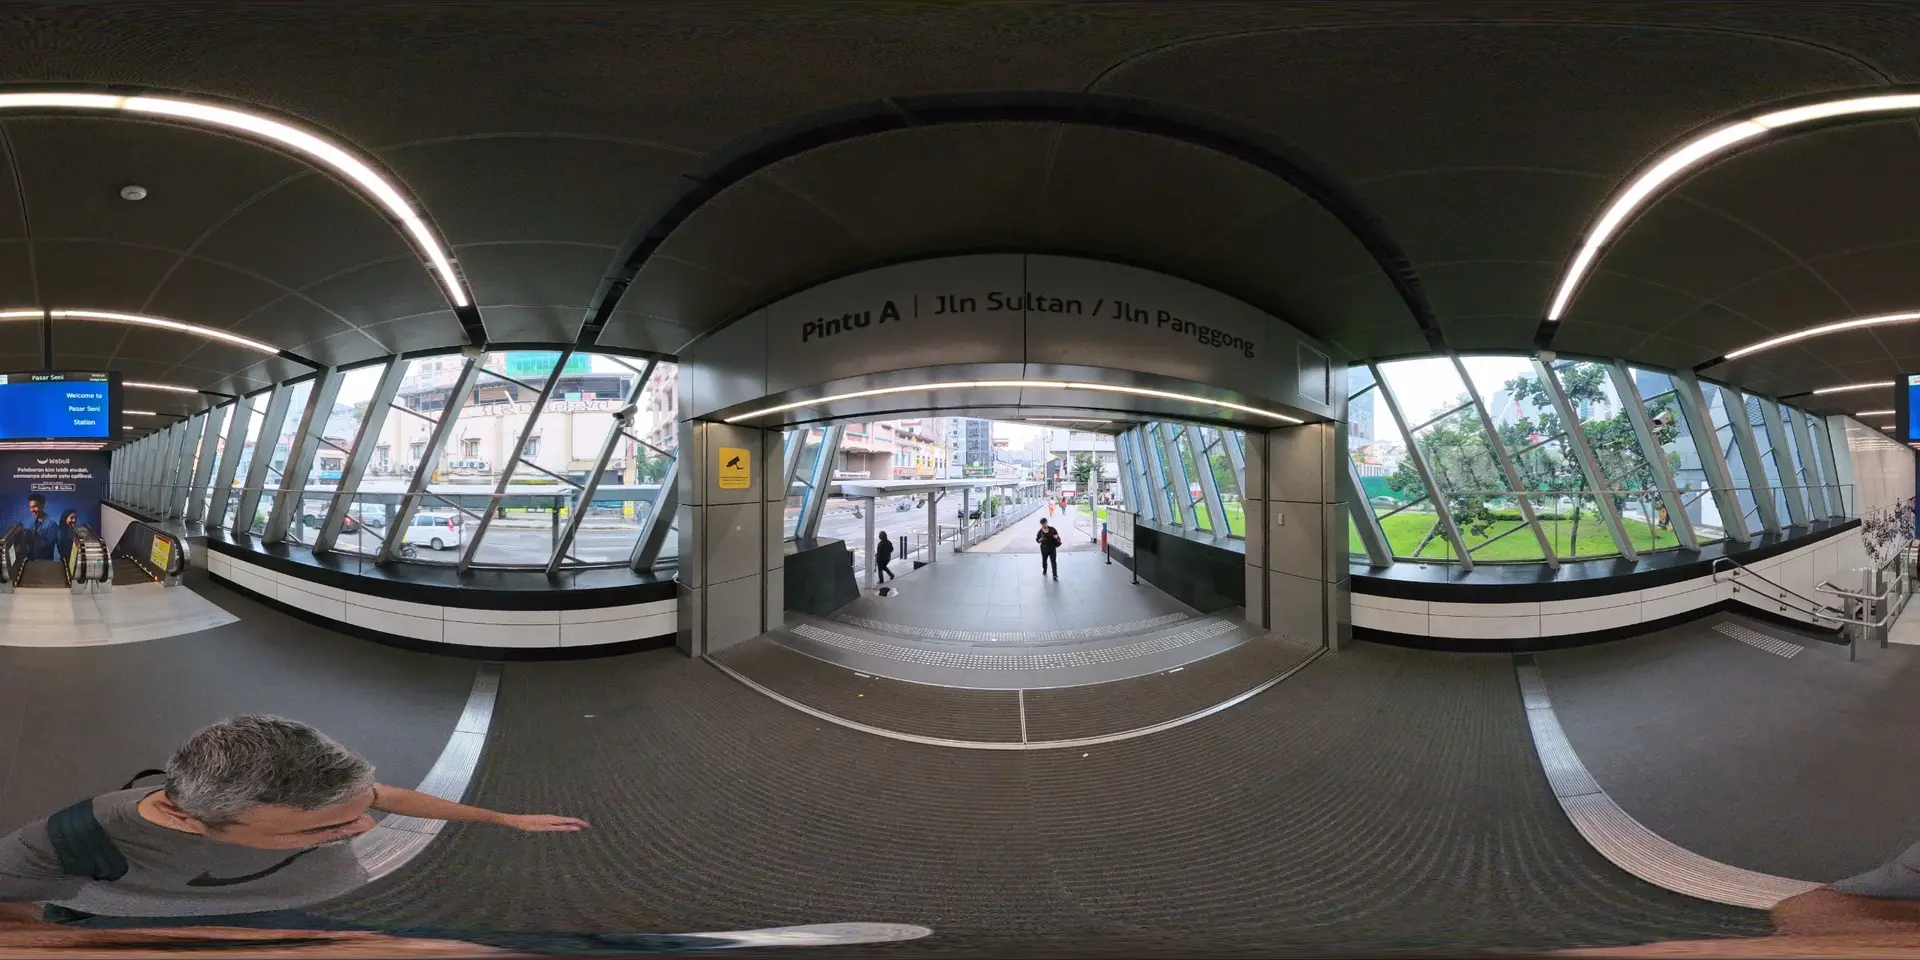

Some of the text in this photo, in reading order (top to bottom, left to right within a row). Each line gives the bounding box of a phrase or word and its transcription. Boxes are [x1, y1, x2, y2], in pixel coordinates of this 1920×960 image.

[800, 300, 901, 344] Pintu A
[934, 295, 976, 316] Jln
[987, 291, 1083, 316] Sultan
[1112, 300, 1149, 325] Jln
[1157, 309, 1255, 359] Panggong
